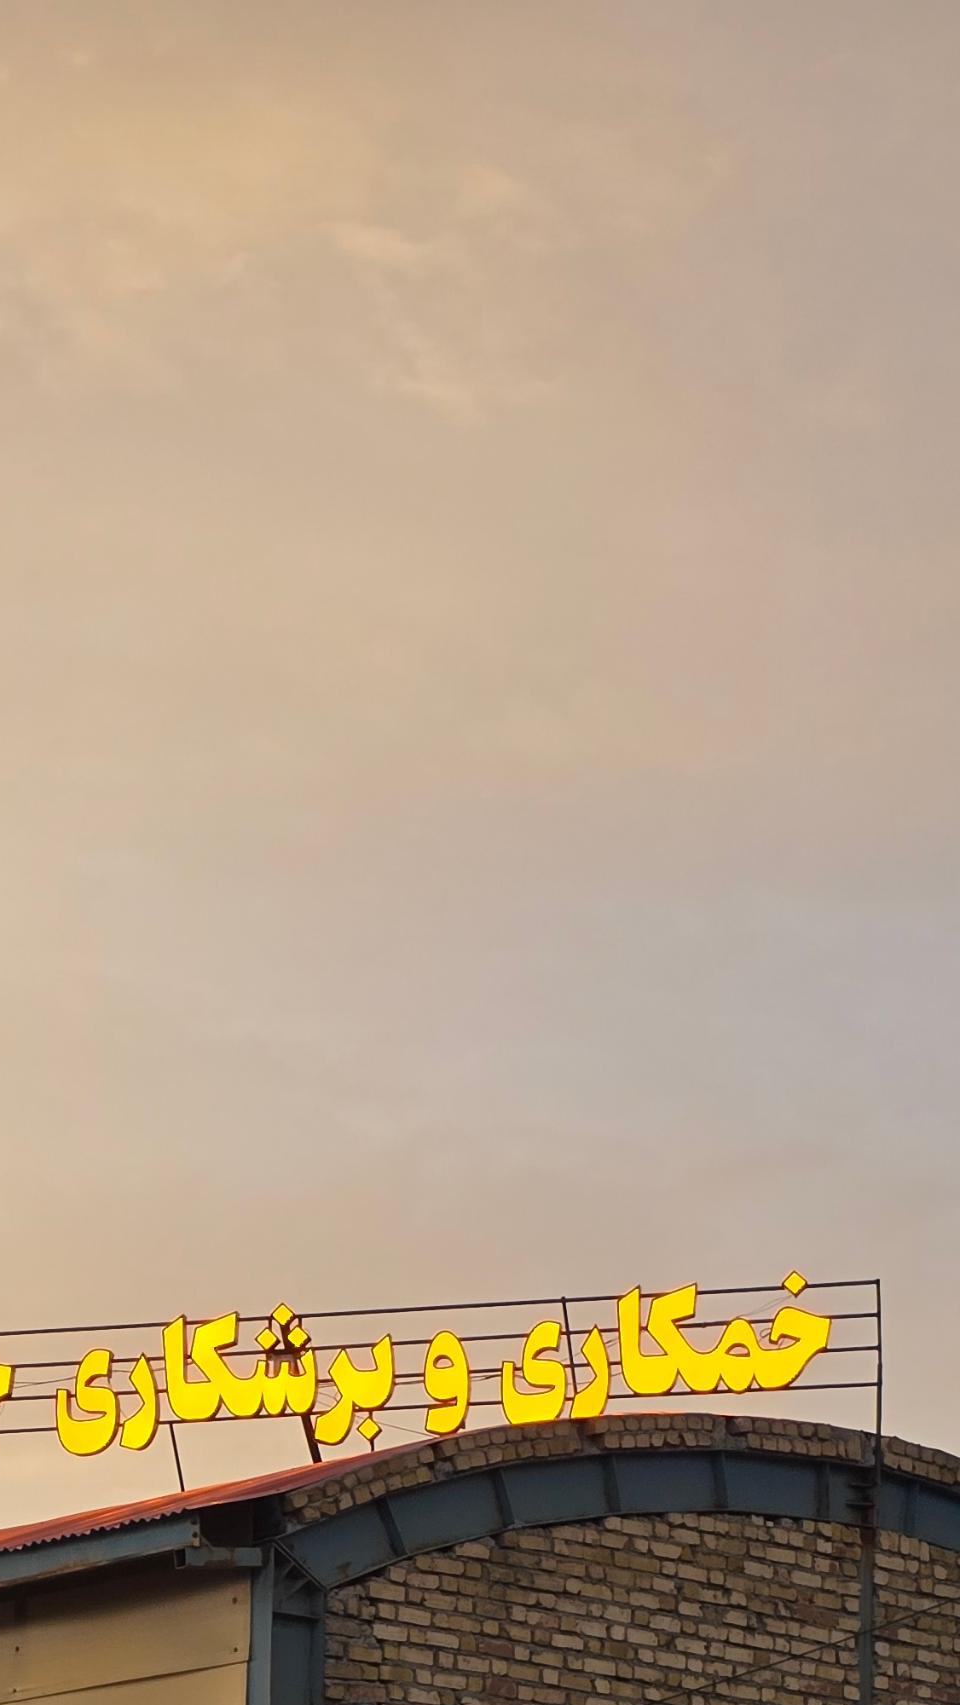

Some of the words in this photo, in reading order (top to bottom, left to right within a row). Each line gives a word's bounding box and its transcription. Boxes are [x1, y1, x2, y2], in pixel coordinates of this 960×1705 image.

[55, 1305, 394, 1456] برشکاری
[423, 1330, 470, 1434] و
[501, 1273, 832, 1426] خمکاری
